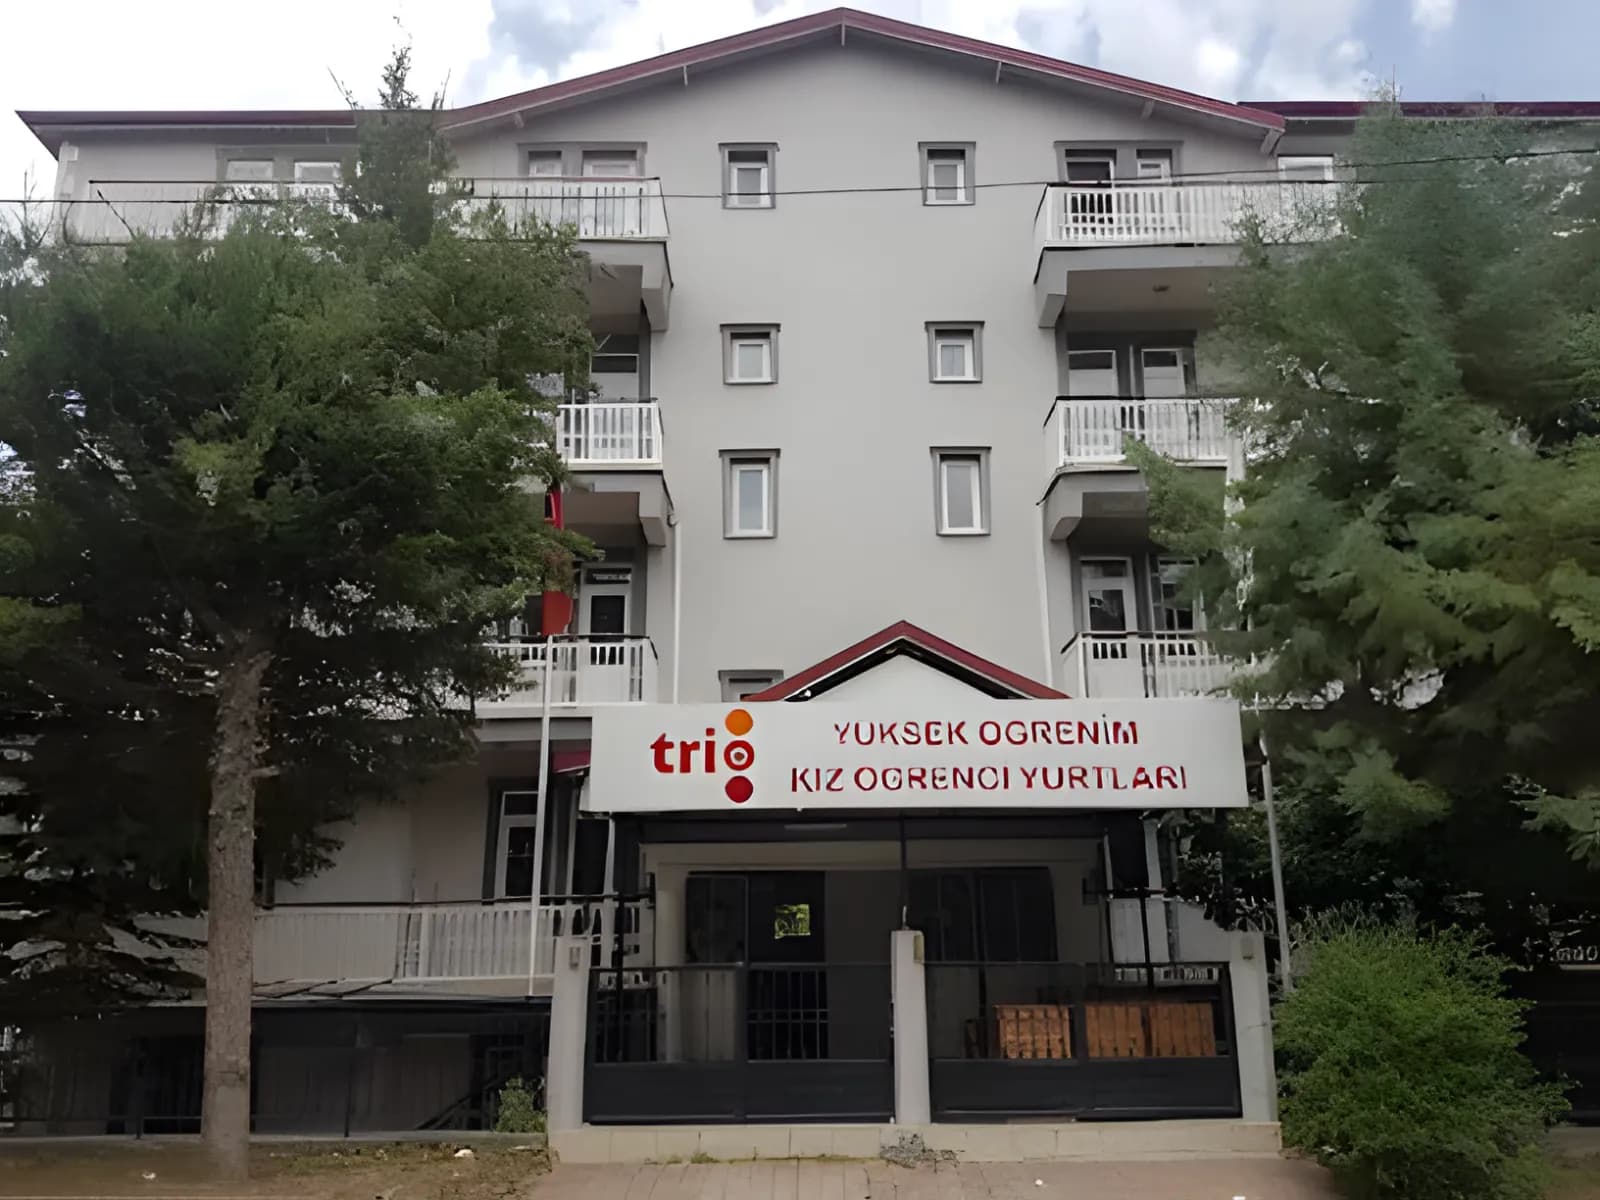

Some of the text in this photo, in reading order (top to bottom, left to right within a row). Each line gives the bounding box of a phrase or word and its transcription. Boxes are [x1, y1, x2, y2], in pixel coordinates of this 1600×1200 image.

[650, 728, 754, 771] trio
[791, 767, 844, 792] KIZ
[1019, 766, 1187, 790] YURTLARI
